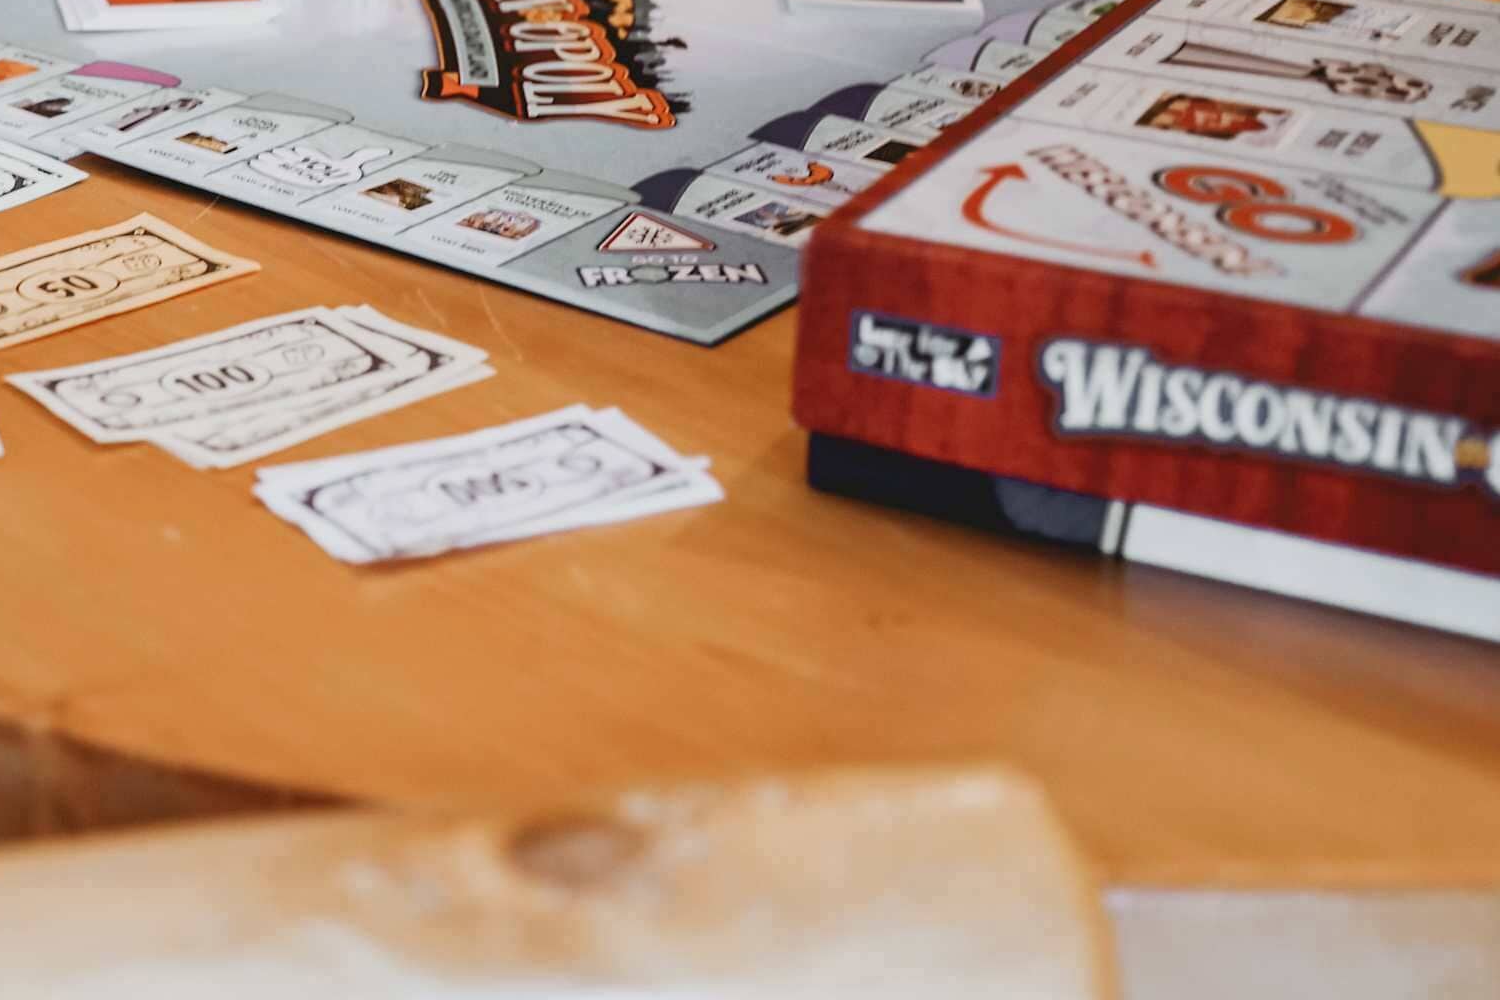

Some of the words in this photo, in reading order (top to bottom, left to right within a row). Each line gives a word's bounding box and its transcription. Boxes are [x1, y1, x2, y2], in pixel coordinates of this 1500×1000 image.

[36, 273, 99, 298] 50
[174, 365, 255, 394] 100
[1042, 339, 1466, 482] WISCONSIN
